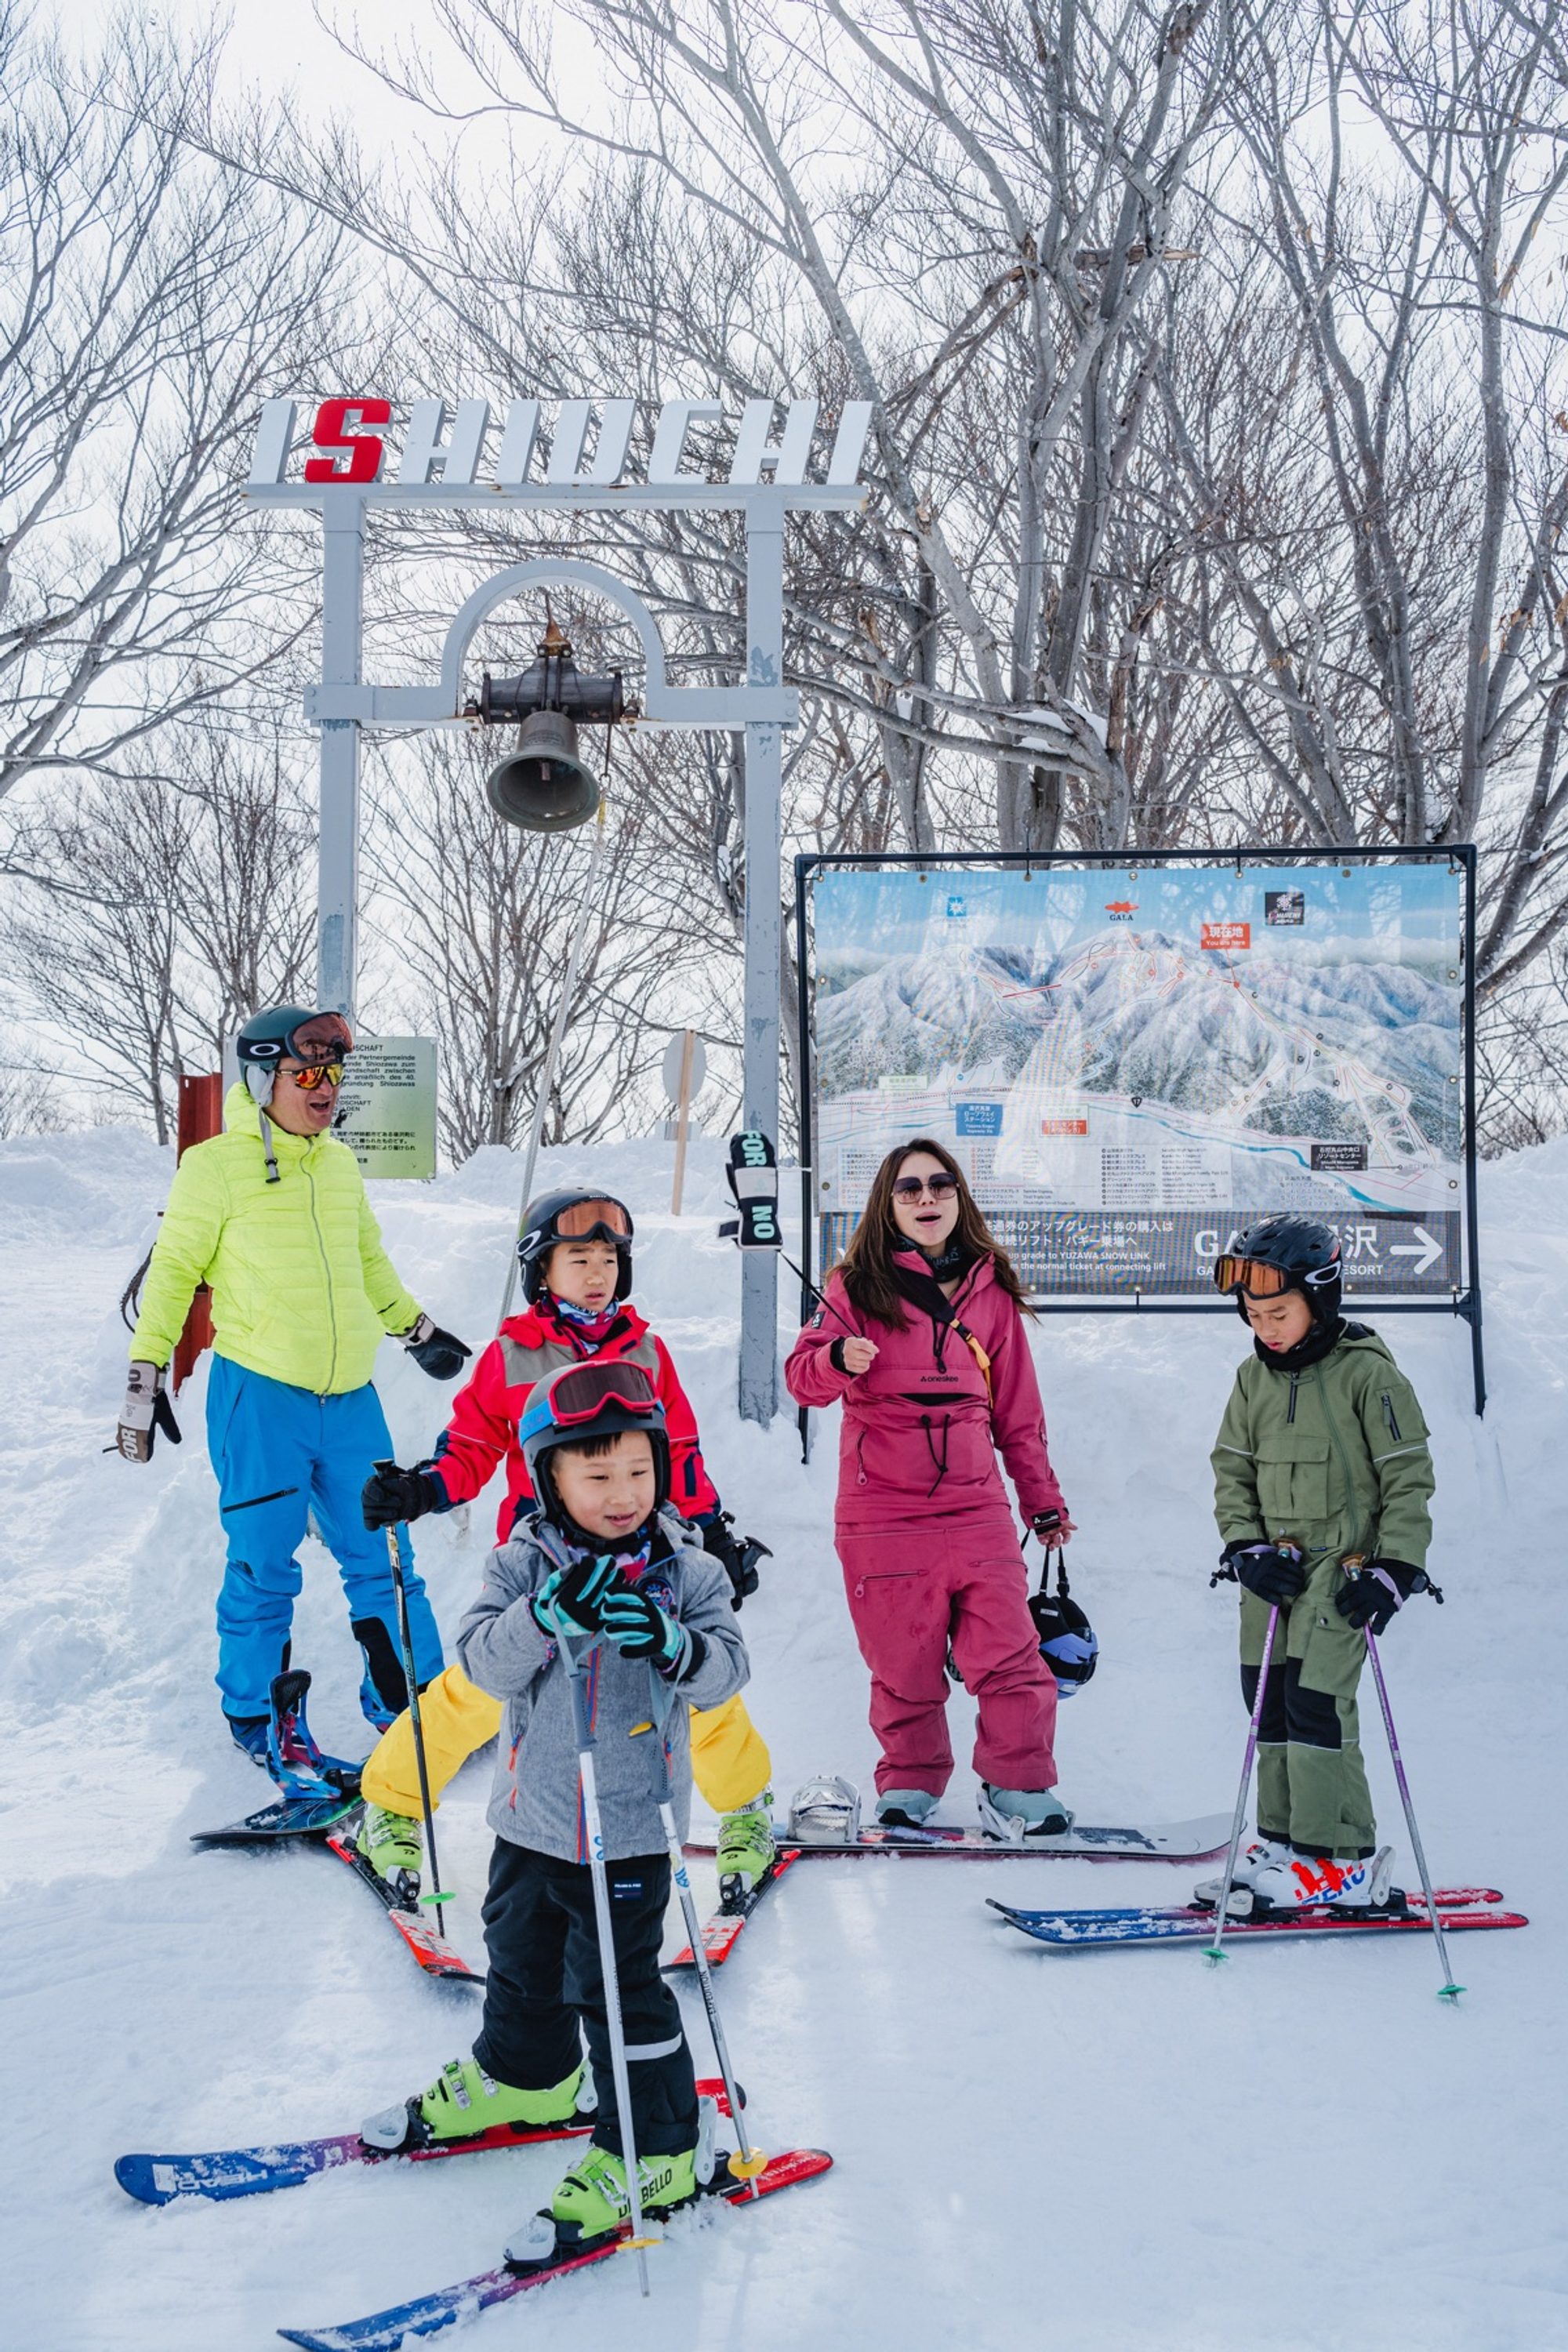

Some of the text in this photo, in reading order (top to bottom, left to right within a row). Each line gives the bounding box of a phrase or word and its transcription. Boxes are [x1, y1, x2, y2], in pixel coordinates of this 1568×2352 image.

[247, 398, 873, 485] ISHIUCHI
[1209, 926, 1243, 938] 現在地
[739, 1130, 767, 1167] FOR
[752, 1205, 775, 1239] NO
[1022, 1250, 1047, 1260] grade
[1060, 1250, 1098, 1259] YUZAWA
[1069, 1261, 1094, 1270] ticket
[1105, 1262, 1152, 1272] connecting
[1343, 1264, 1384, 1276] ESORT
[618, 2168, 673, 2219] DBELLO
